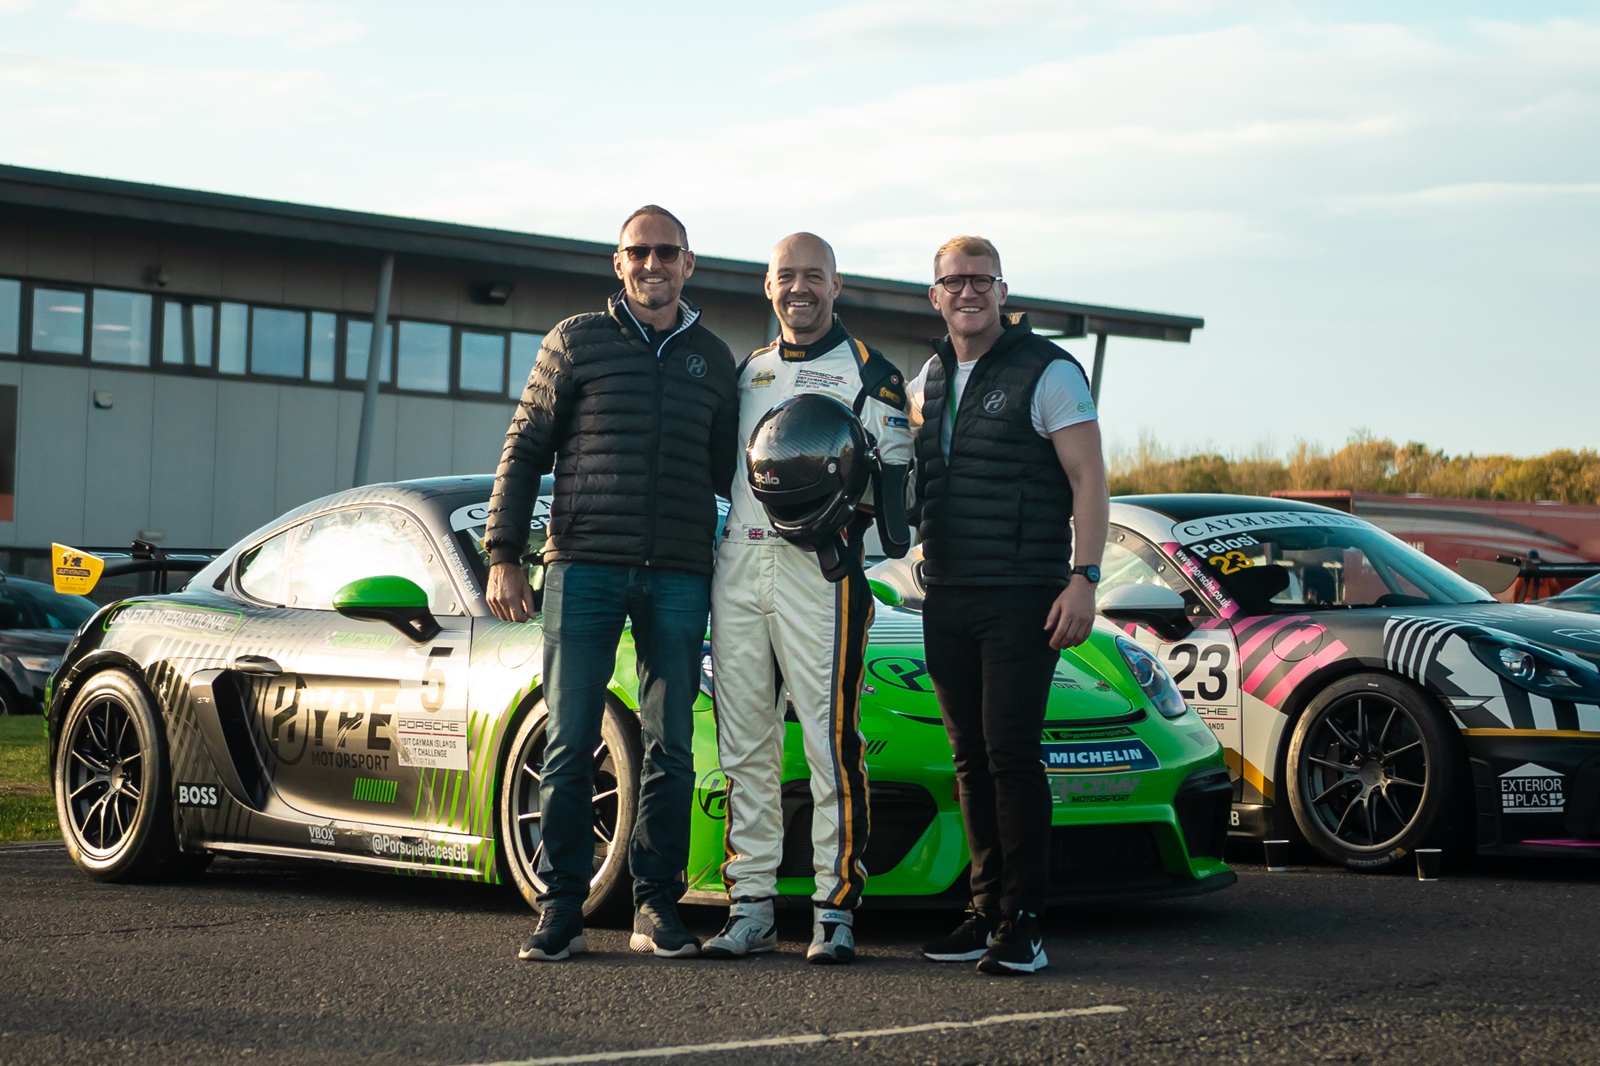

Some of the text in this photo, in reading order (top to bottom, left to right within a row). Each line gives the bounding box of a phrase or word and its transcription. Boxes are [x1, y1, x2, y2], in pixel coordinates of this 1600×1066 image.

[1183, 514, 1294, 536] CAYMAN
[1189, 533, 1259, 559] Pelosi
[441, 533, 481, 602] www.porsche.co.uk
[1209, 551, 1255, 575] 23
[1176, 549, 1231, 609] www.porsche.co.uk
[109, 609, 230, 631] LASLETT INTERNATIONAL
[421, 646, 454, 713] 5
[1168, 643, 1230, 701] 23
[398, 720, 459, 732] PORSCHE
[412, 738, 433, 747] CAYMAN
[311, 751, 390, 771] MOTORSPORT
[418, 748, 448, 758] CHALLENGE
[1049, 748, 1143, 764] MICHELIN
[179, 785, 217, 805] BOSS
[1501, 778, 1562, 792] EXTERIOR
[1071, 794, 1131, 803] MOTORSPORT
[1515, 793, 1548, 807] PLAS
[309, 826, 334, 840] VBOX
